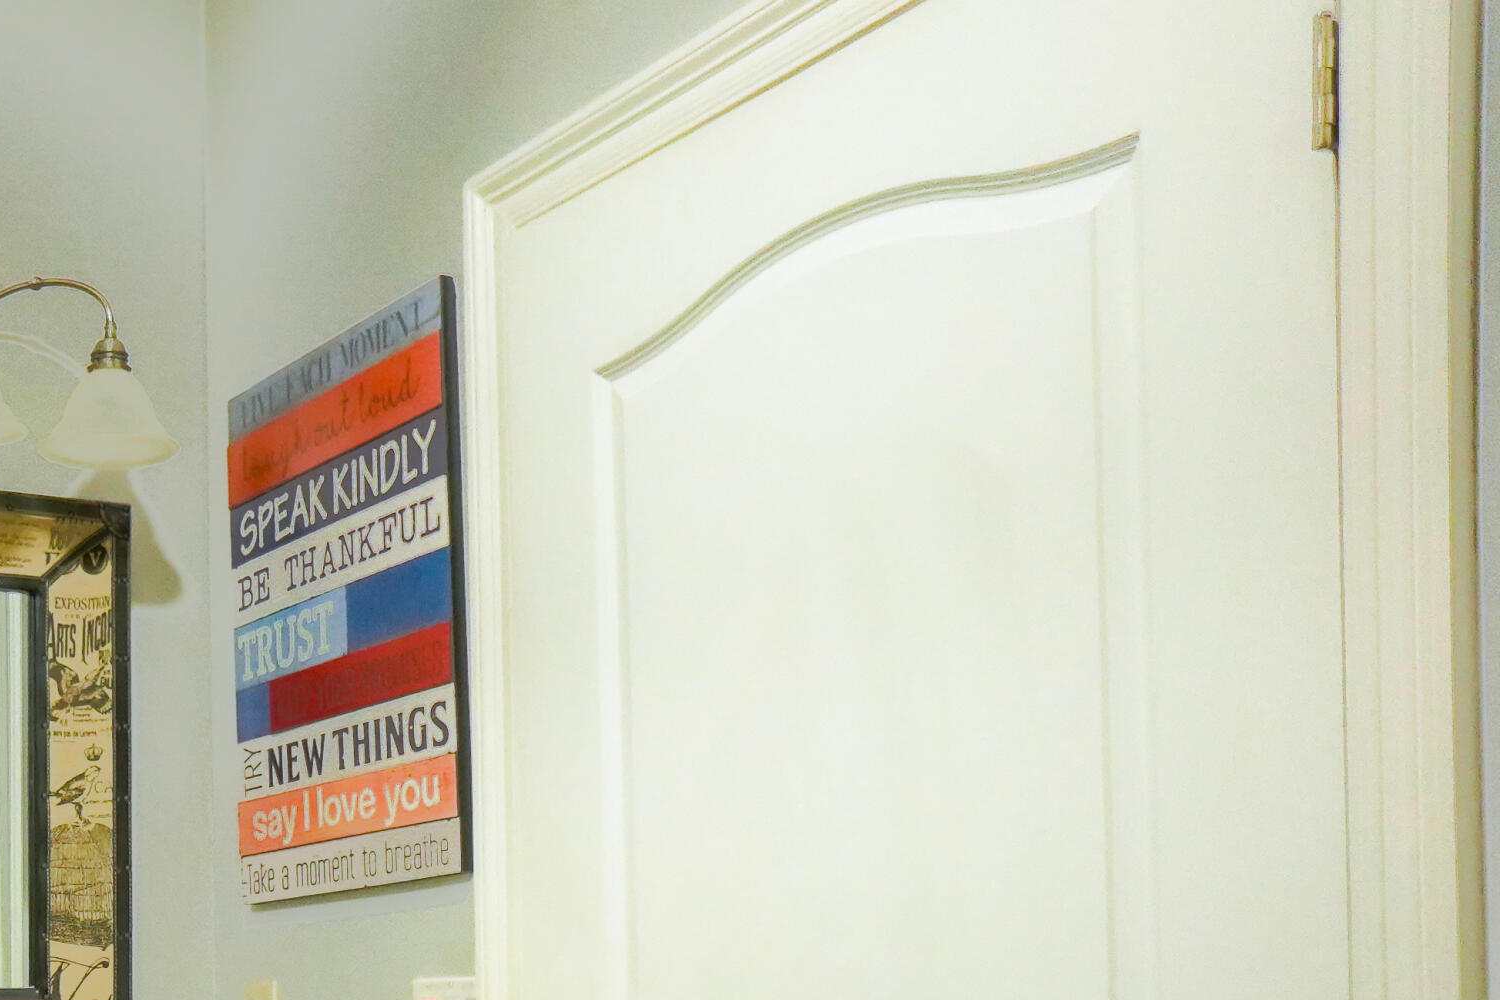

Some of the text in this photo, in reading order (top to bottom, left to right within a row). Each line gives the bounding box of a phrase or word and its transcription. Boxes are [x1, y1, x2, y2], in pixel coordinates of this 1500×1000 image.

[340, 298, 422, 366] MOMENT
[314, 396, 350, 445] out
[360, 356, 420, 423] loud
[239, 419, 437, 556] SPEAK KINDLY
[238, 497, 441, 612] BE THANKFUL
[237, 601, 333, 681] TRUST
[243, 701, 450, 798] TRY NEW THINGS
[252, 775, 441, 846] say I love you
[247, 832, 449, 895] Take a moment to breathe
